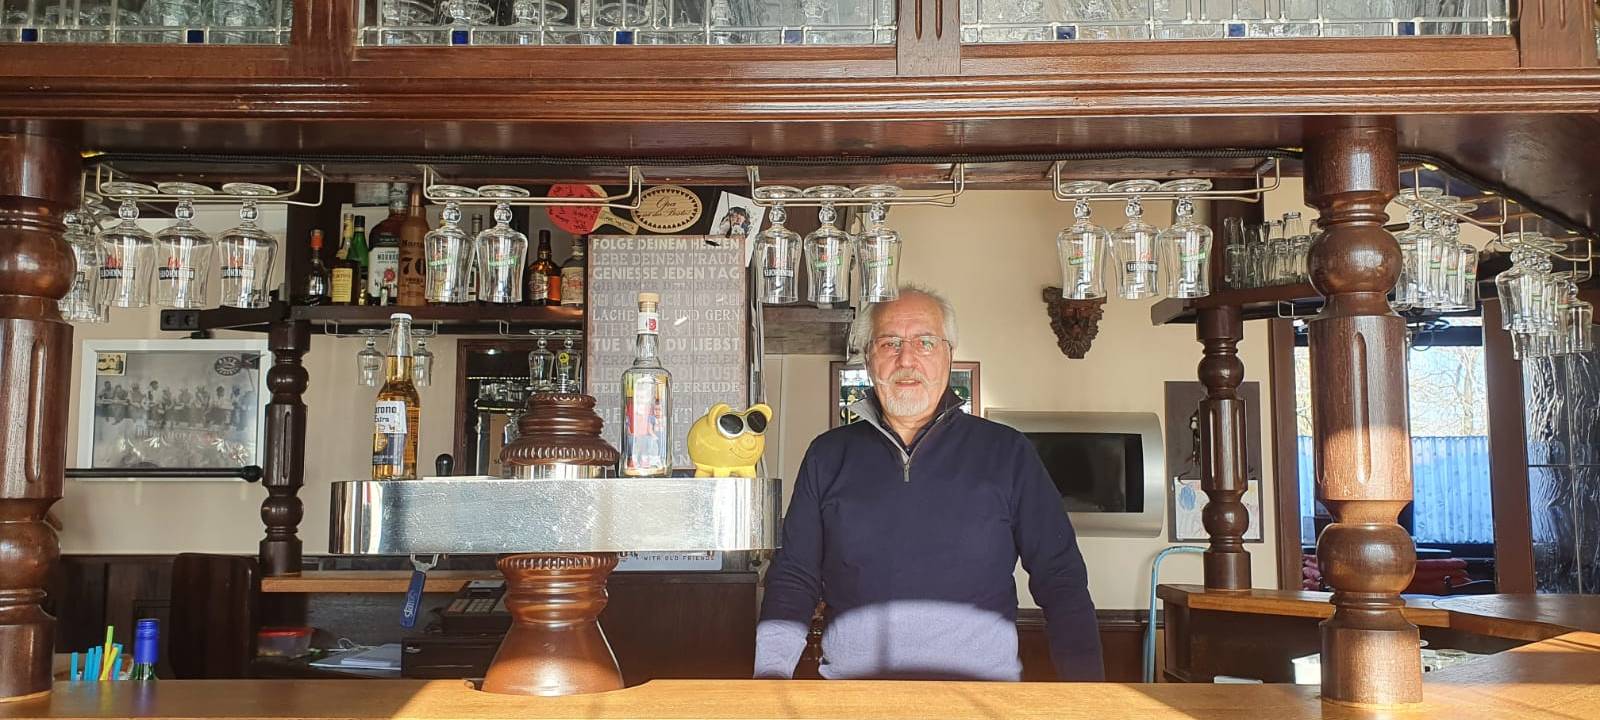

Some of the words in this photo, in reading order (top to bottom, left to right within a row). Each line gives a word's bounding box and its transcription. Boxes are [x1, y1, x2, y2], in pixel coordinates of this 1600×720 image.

[592, 238, 634, 250] FOLGE
[637, 238, 688, 250] DEINEM
[691, 238, 740, 250] HEEN
[592, 253, 628, 265] LEBE
[632, 253, 684, 265] DEINEN
[688, 253, 739, 265] TRAUM
[592, 267, 659, 280] GENIESSE
[661, 267, 705, 280] JEDEN
[707, 267, 740, 280] TAG
[592, 309, 636, 321] LACHE
[674, 309, 700, 321] UND
[704, 309, 740, 321] GERN
[592, 338, 620, 352] TUE
[665, 338, 688, 352] DU
[690, 338, 740, 352] LIEBST
[682, 383, 740, 394] FREUDE
